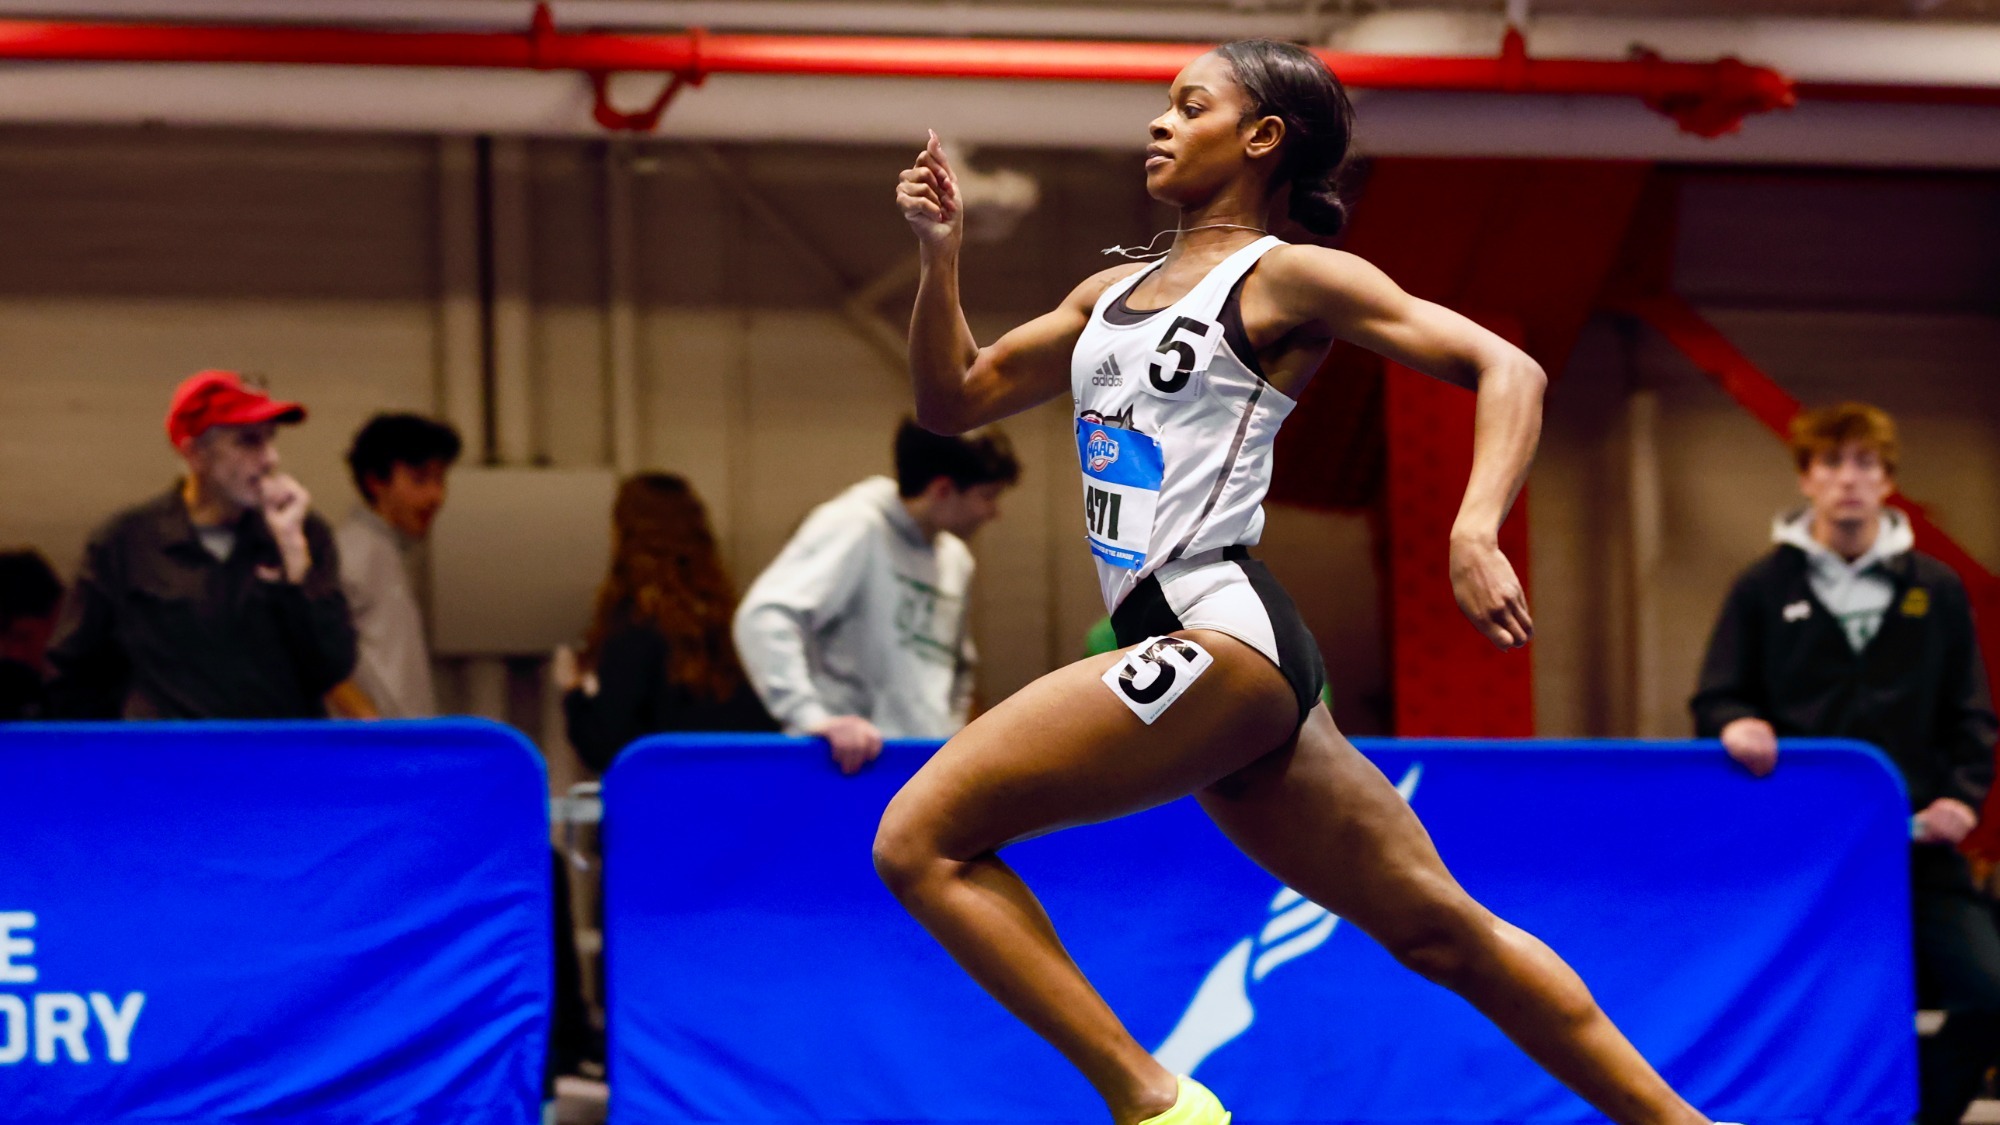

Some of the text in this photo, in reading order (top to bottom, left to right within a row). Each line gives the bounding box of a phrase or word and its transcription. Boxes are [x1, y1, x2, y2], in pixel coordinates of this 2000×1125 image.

[1091, 374, 1123, 387] adidas
[1149, 315, 1210, 393] 5
[1086, 484, 1122, 541] 471
[1118, 637, 1199, 705] 5
